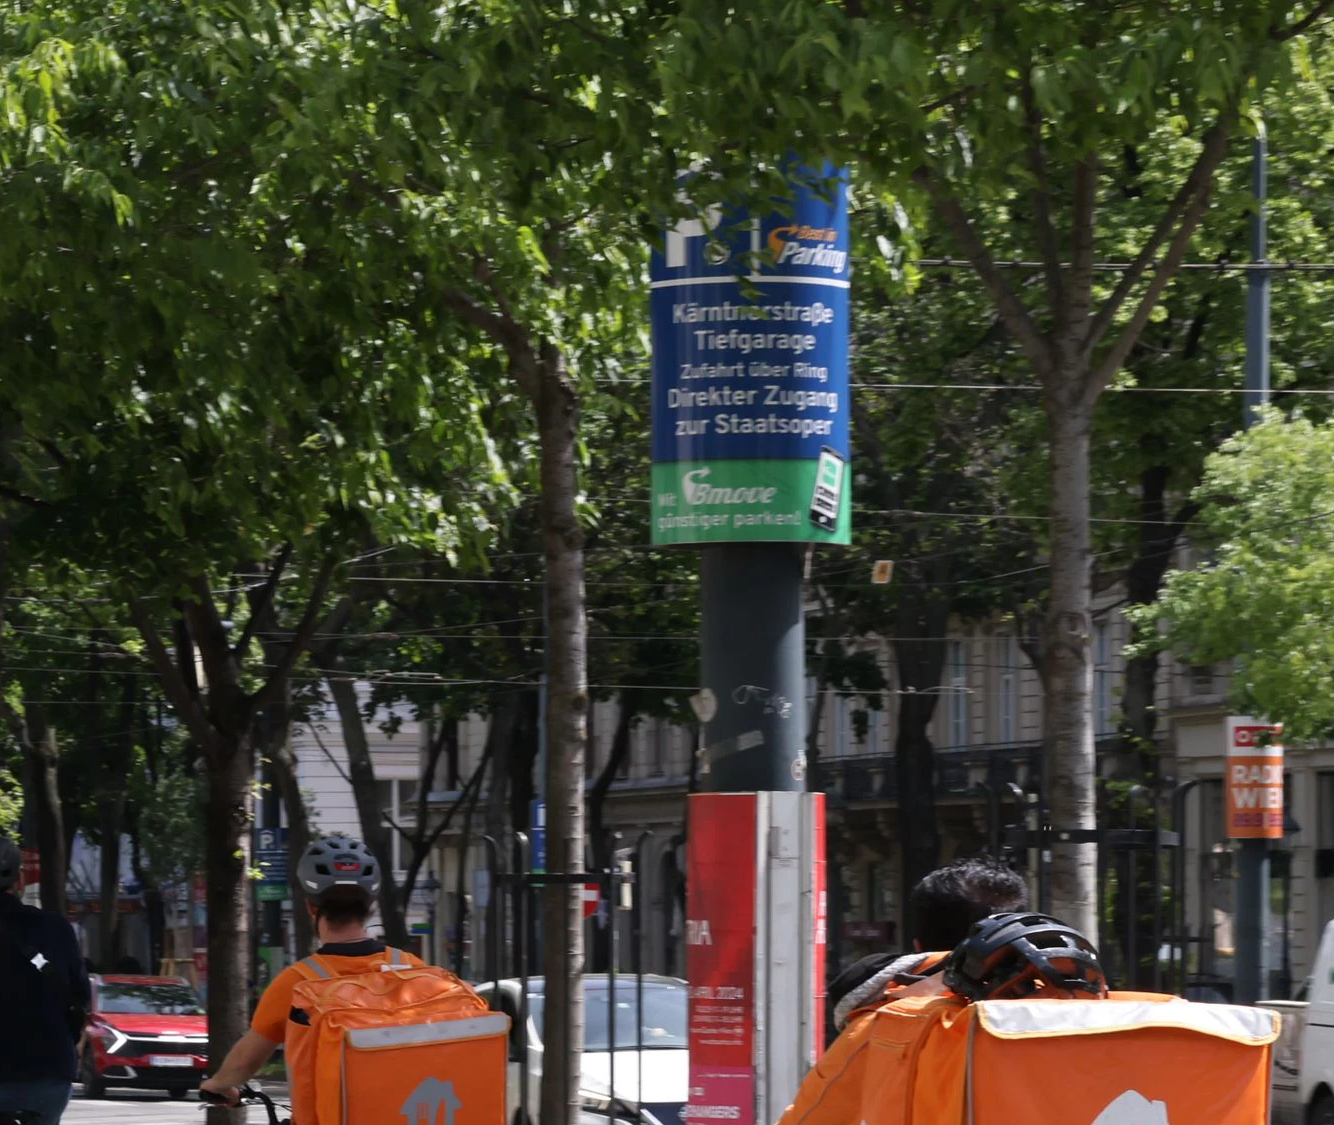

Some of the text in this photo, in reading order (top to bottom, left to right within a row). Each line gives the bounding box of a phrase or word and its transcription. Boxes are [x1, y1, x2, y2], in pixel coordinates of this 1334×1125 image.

[777, 241, 848, 274] Parking
[694, 328, 817, 355] Tiefgarage
[680, 361, 828, 383] Zufahrt über Ring
[668, 385, 839, 413] Direkter Zugang
[675, 413, 834, 438] zur Staatsoper
[733, 511, 802, 528] parken!
